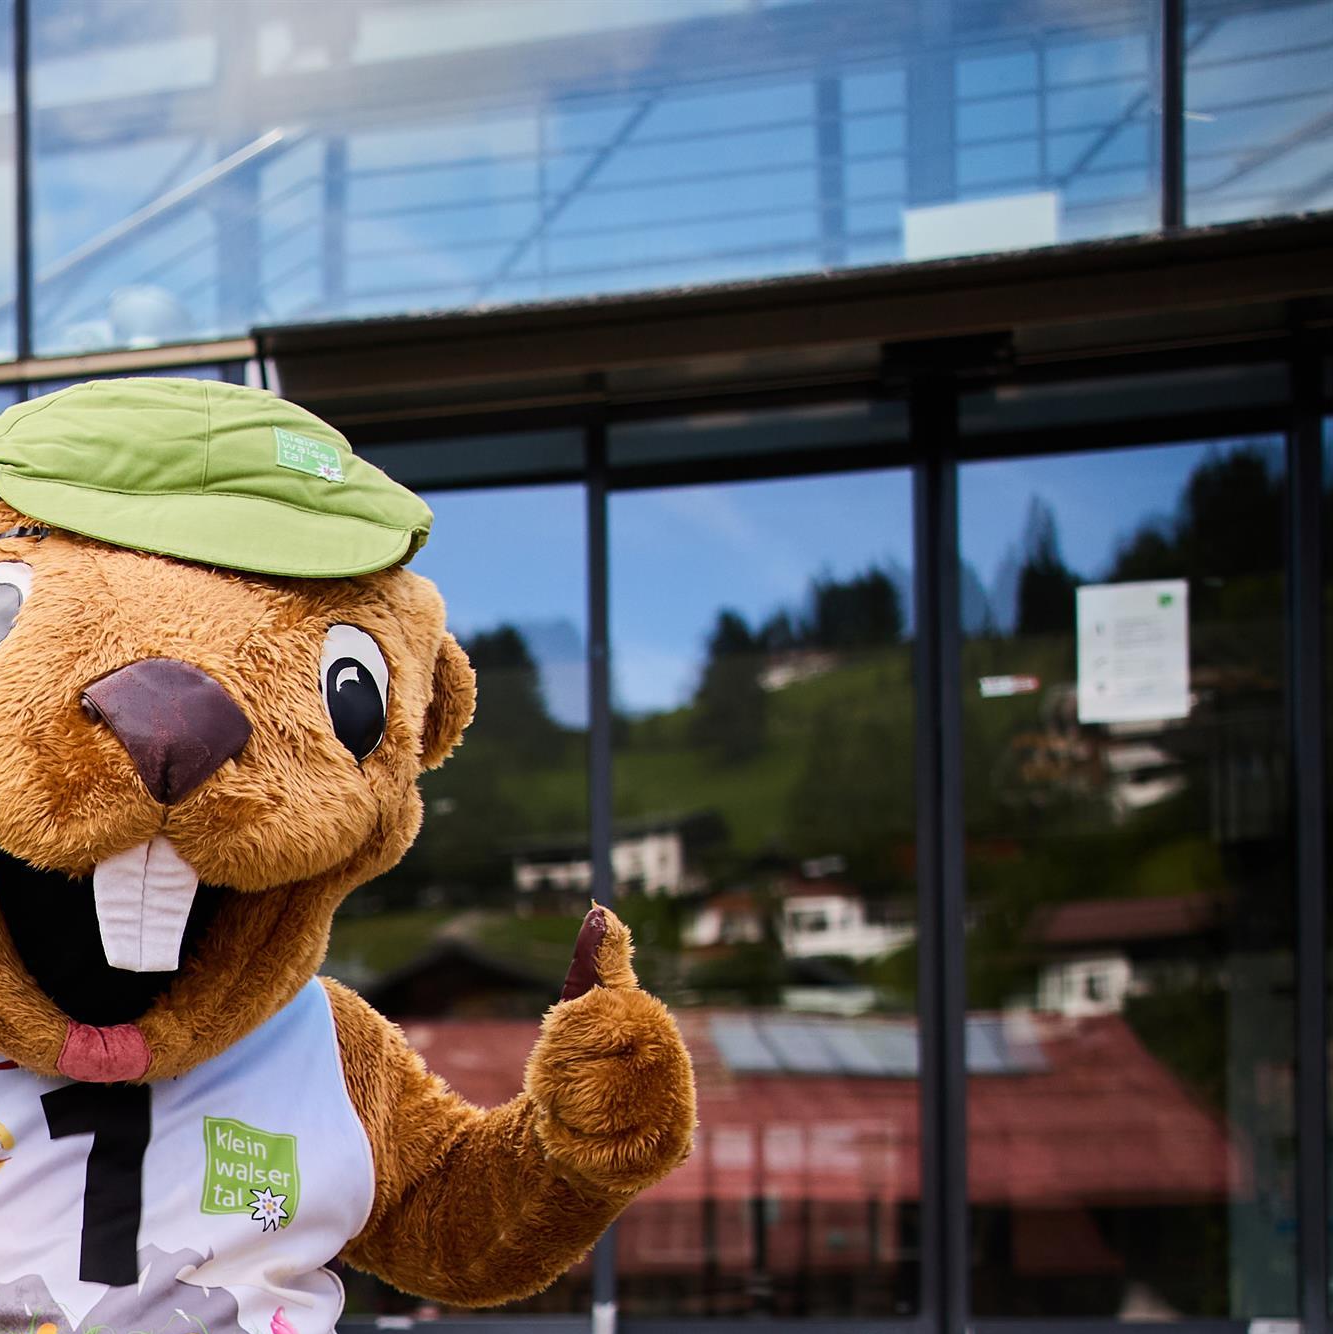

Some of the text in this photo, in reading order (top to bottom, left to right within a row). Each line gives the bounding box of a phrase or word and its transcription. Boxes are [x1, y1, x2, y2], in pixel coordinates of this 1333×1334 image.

[279, 431, 319, 450] klein
[280, 440, 336, 463] walser
[282, 448, 304, 464] tal
[215, 1126, 267, 1160] klein
[39, 1082, 152, 1287] 1
[214, 1158, 292, 1188] walser
[213, 1184, 244, 1207] tal
